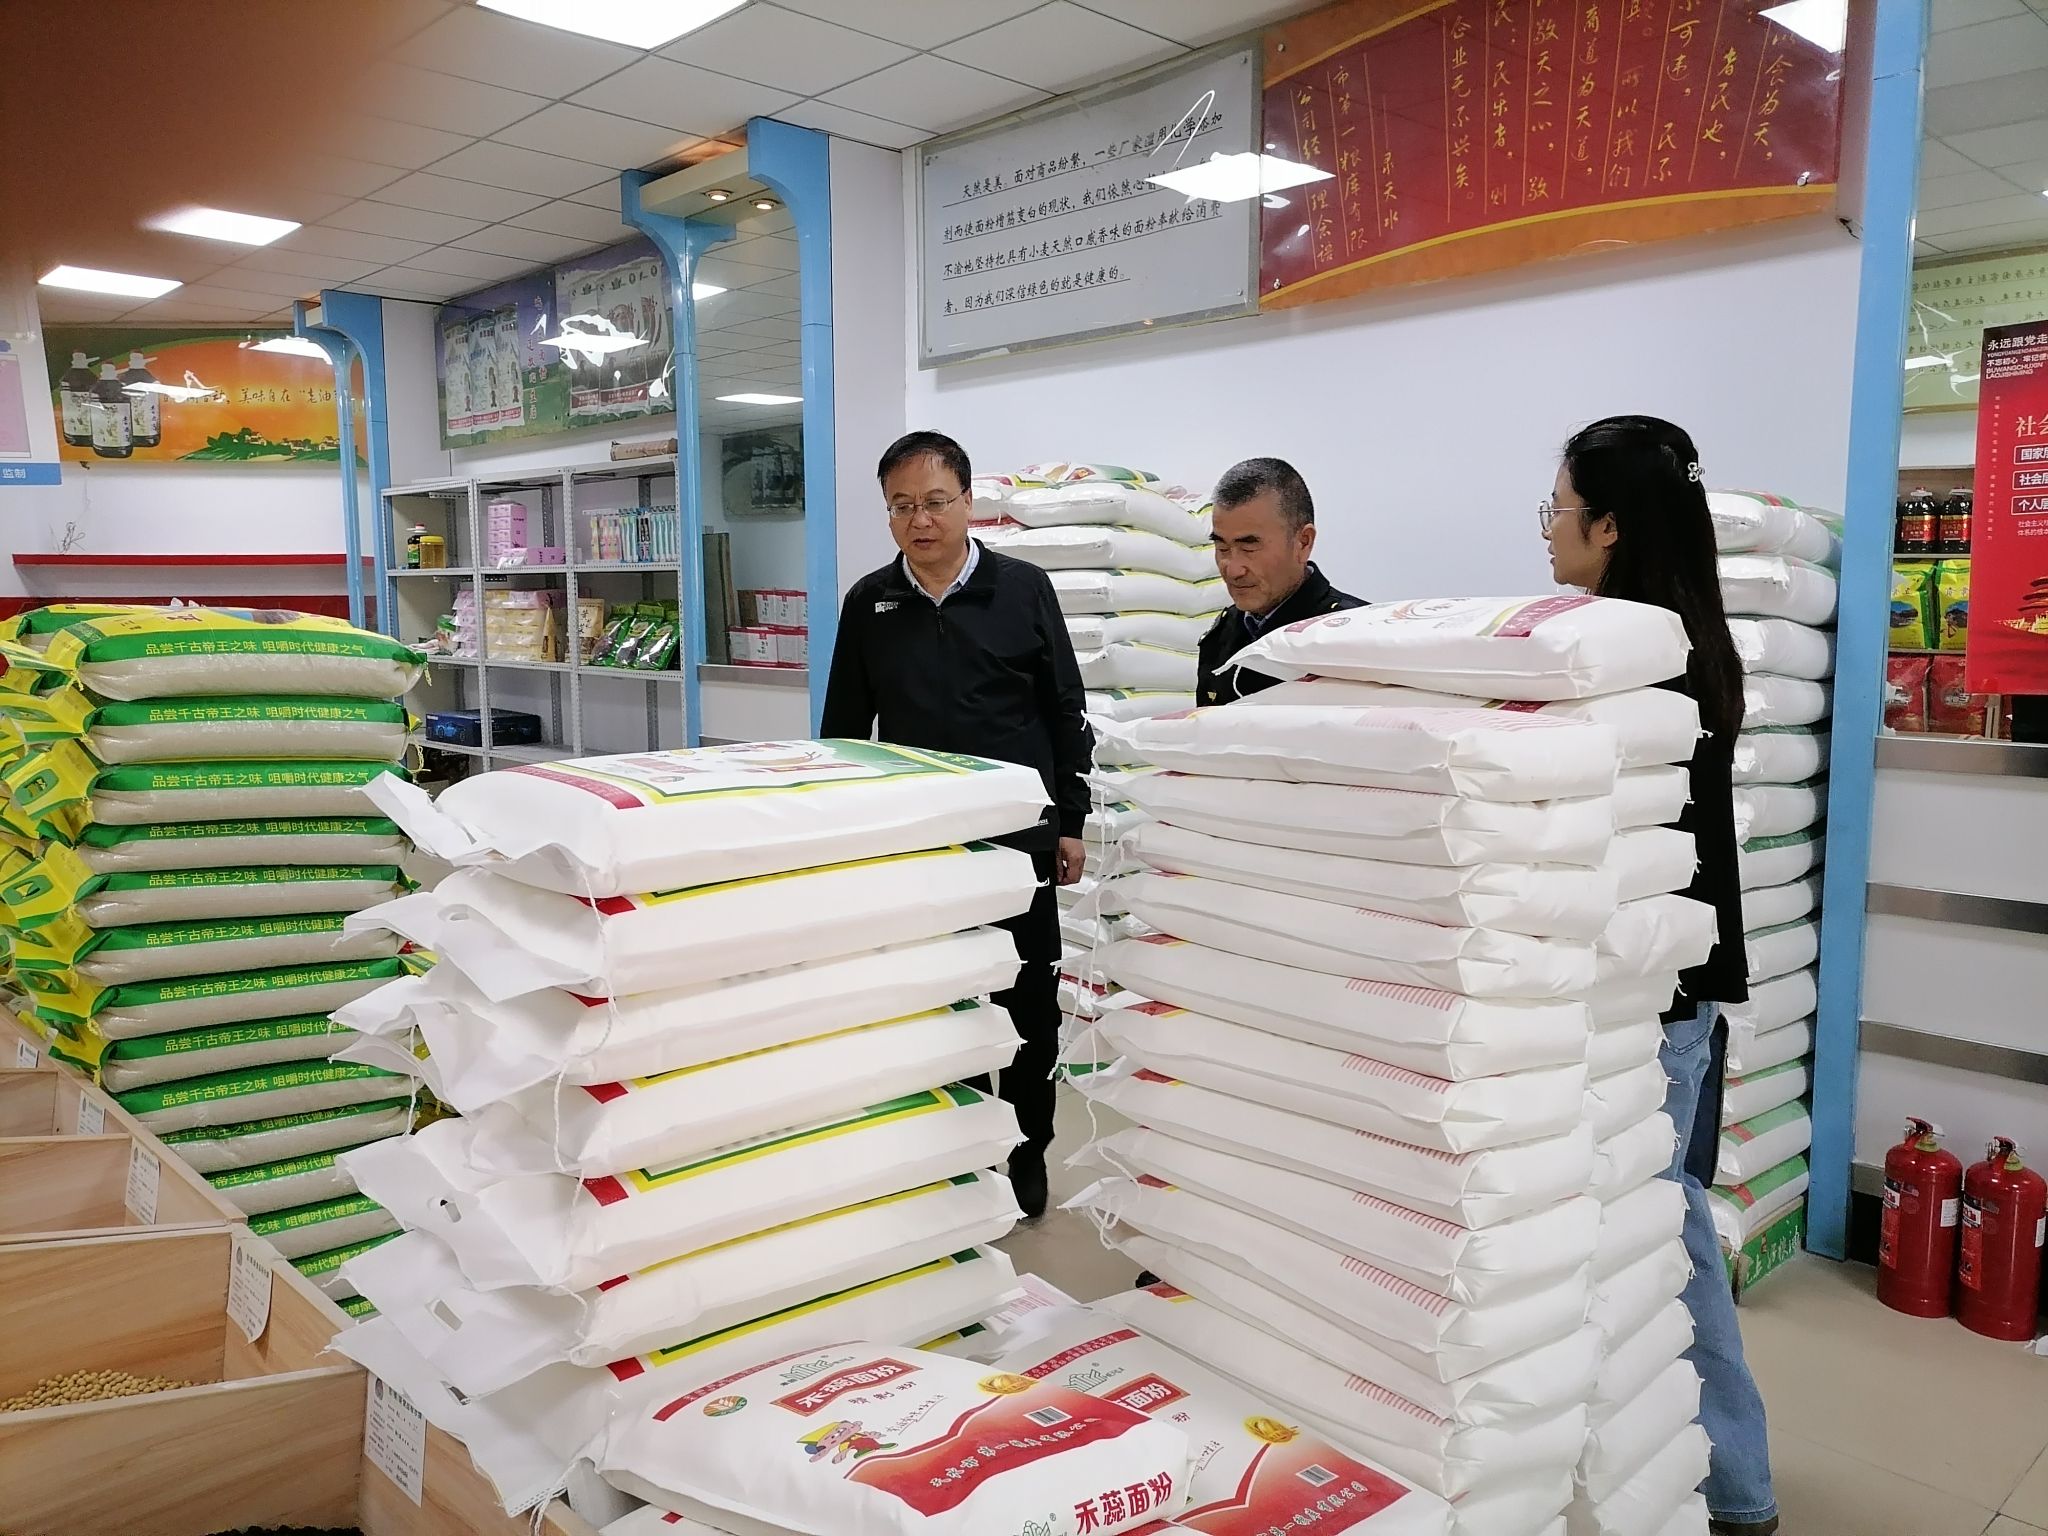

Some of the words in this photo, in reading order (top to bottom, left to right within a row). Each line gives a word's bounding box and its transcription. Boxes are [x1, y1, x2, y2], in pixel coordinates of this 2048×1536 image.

[1988, 334, 2048, 350] 永远跟党走
[1986, 357, 2018, 367] 不忘初心
[2022, 353, 2048, 362] 牢记使
[146, 641, 257, 656] 品尝千古帝王之味
[263, 640, 366, 657] 咀嚼时代健康之气
[150, 706, 259, 721] 品尝千古帝王之味
[266, 705, 367, 720] 咀嚼时代健康之气
[153, 773, 262, 788] 品尝千古帝王之味
[268, 771, 370, 785] 咀嚼时代健康之气
[150, 823, 259, 838] 品尝千古帝王之味
[266, 821, 368, 834] 咀嚼时代健康之气
[149, 872, 258, 887] 品尝千古帝王之味
[263, 868, 364, 883] 咀嚼时代健康之气
[146, 926, 255, 945] 品尝千古帝王之味
[260, 918, 345, 934] 咀嚼时代健康之
[160, 978, 267, 1000] 品尝千古帝王之味
[271, 966, 371, 987] 咀嚼时代健康之气
[166, 1027, 271, 1052] 品尝千古帝王之味
[162, 1078, 268, 1107] 品尝千古帝王之味
[273, 1065, 371, 1087] 咀嚼时代健康之气
[272, 1154, 337, 1177] 咀嚼时代健
[254, 1220, 280, 1235] 之味
[1112, 1382, 1172, 1410] 面粉
[1074, 1472, 1173, 1535] 禾蕊面粉
